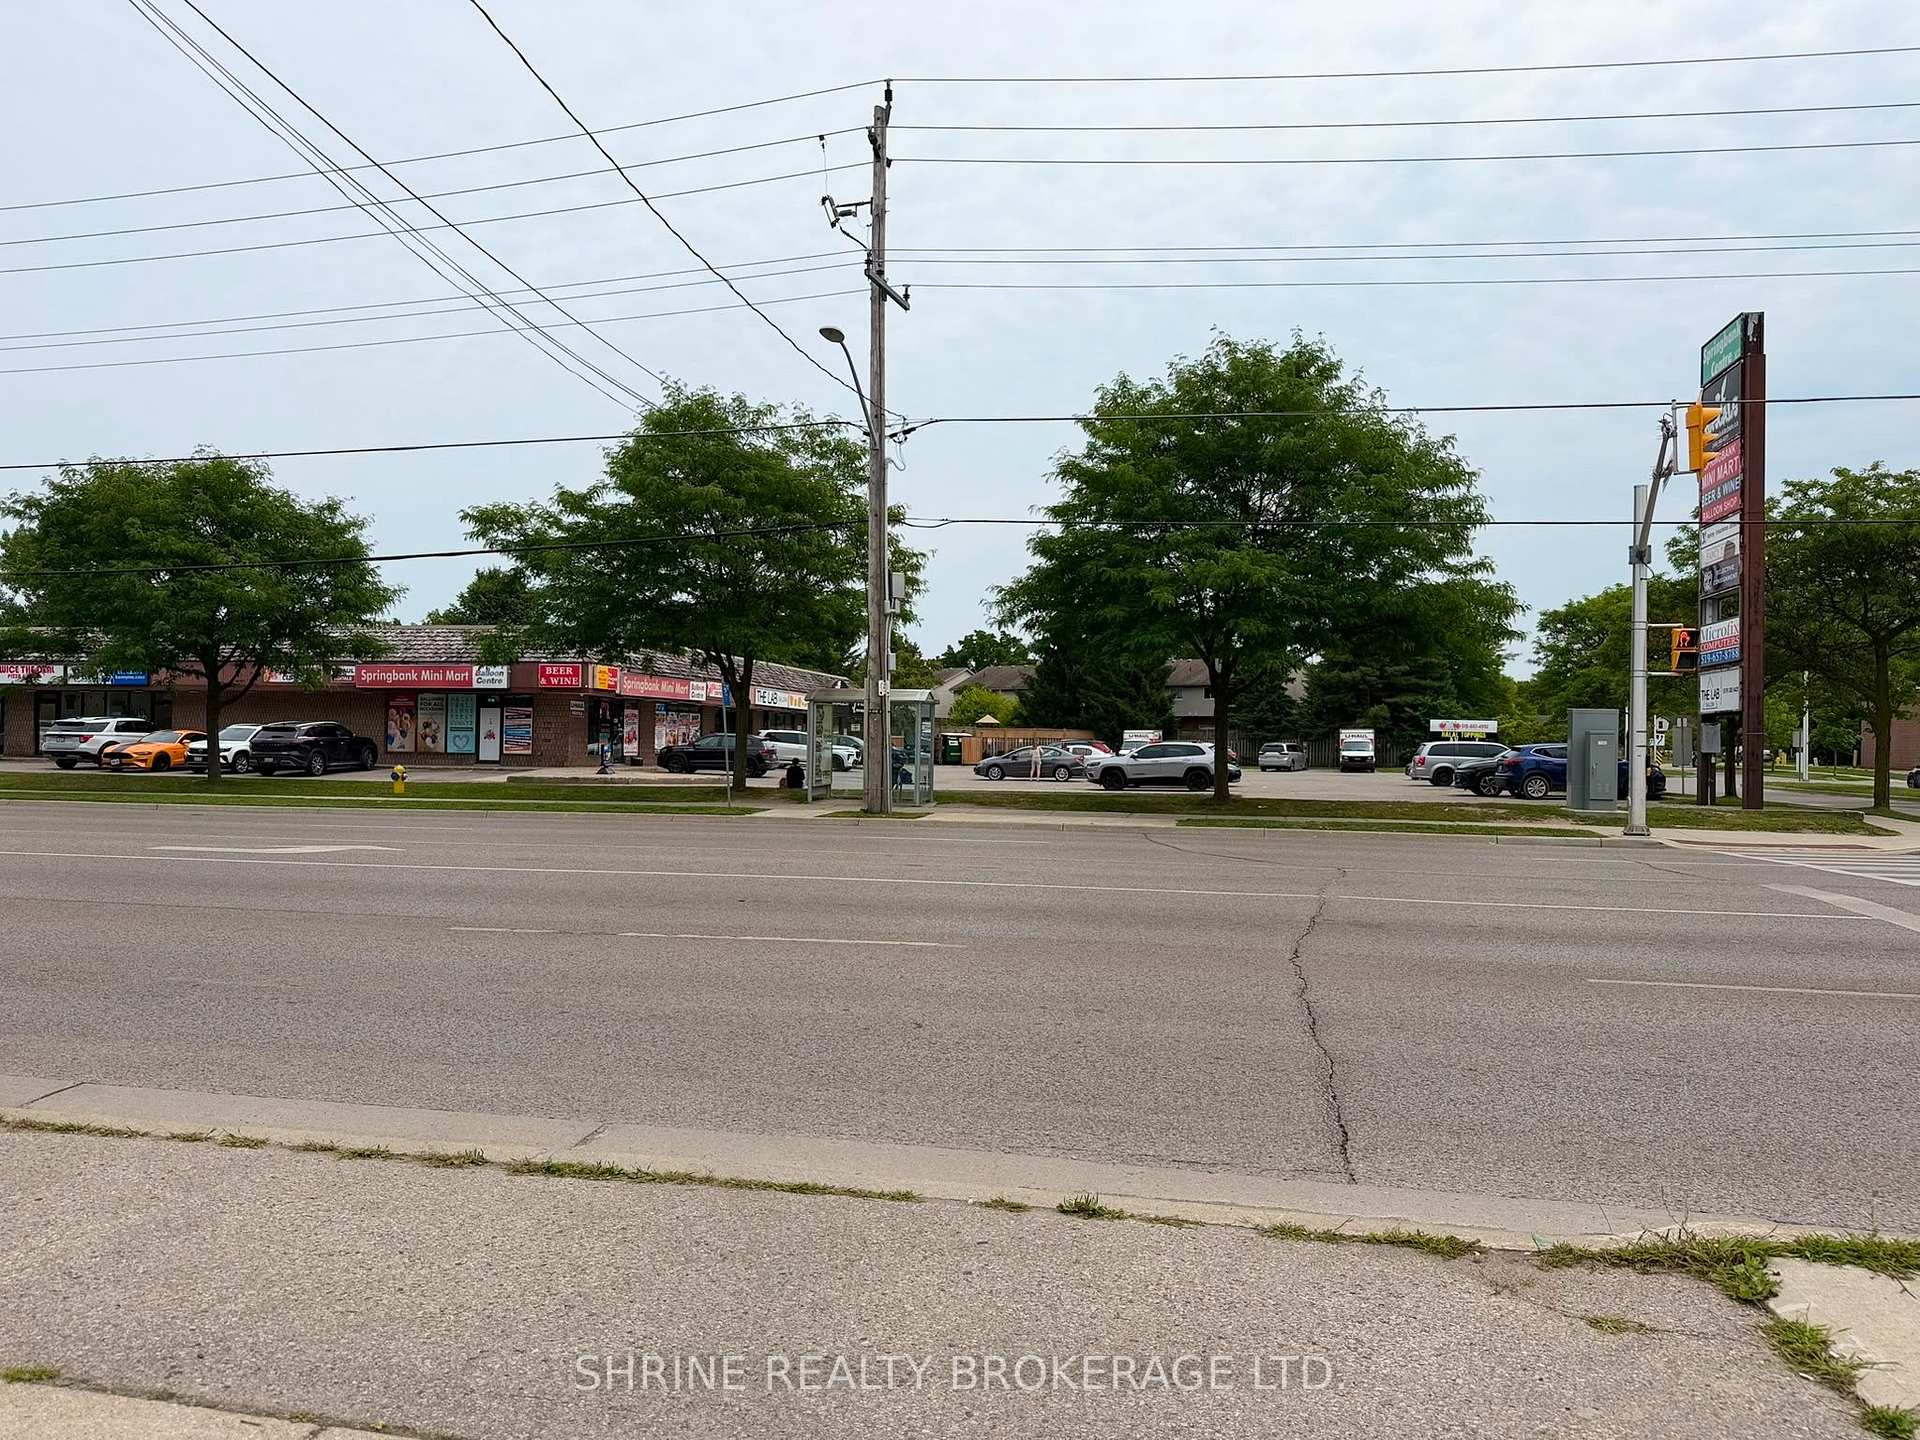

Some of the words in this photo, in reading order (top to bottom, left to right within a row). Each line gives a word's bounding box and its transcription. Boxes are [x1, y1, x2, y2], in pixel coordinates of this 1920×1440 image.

[1718, 456, 1739, 483] MART
[1701, 621, 1740, 641] Microfix
[1701, 637, 1740, 651] COMPUTERS
[0, 665, 18, 674] WICE
[21, 665, 34, 674] THE
[361, 670, 418, 683] Springbank
[421, 669, 443, 681] Mini
[447, 670, 469, 681] Mart
[545, 667, 573, 675] BEER
[550, 677, 579, 685] WINE
[624, 676, 660, 693] Springbank
[757, 690, 767, 704] THE
[768, 692, 778, 705] LAB
[1702, 689, 1710, 701] THE
[1711, 688, 1720, 700] LAB
